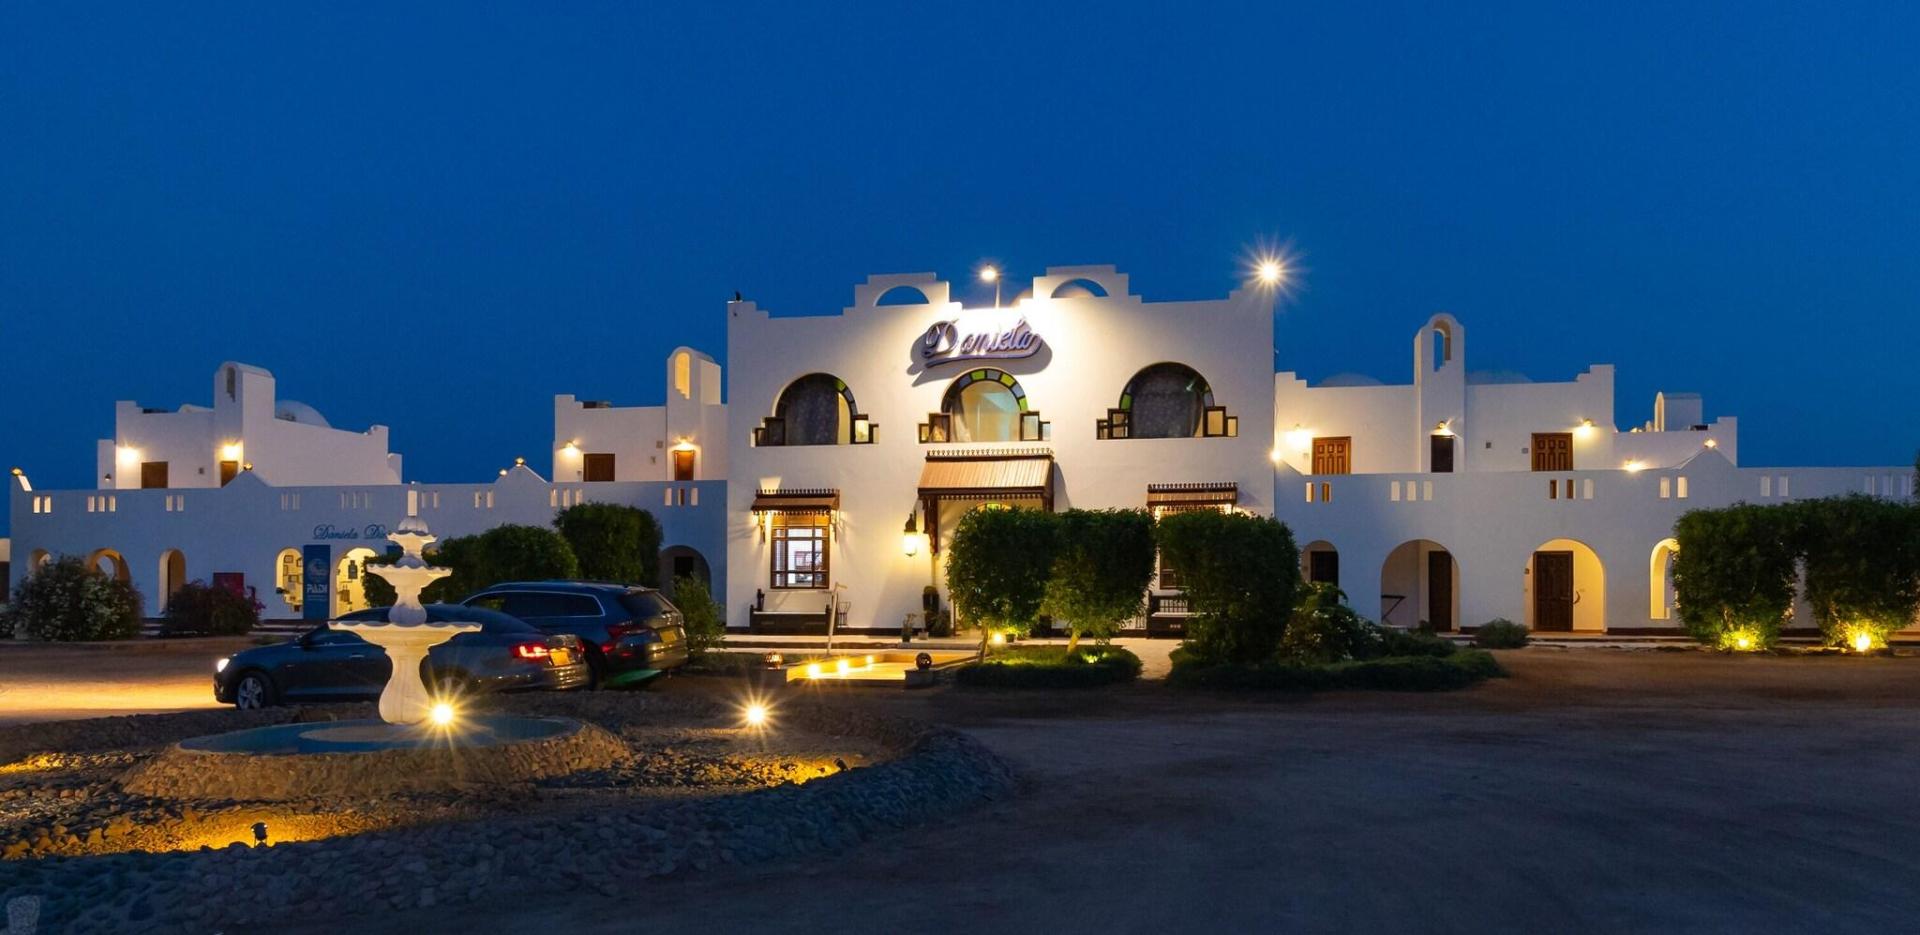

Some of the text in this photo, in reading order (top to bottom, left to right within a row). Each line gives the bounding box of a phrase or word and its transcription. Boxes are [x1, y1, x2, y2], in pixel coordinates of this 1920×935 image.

[921, 315, 1042, 368] Daniela
[312, 524, 358, 540] Daniela
[306, 583, 328, 593] PADI
